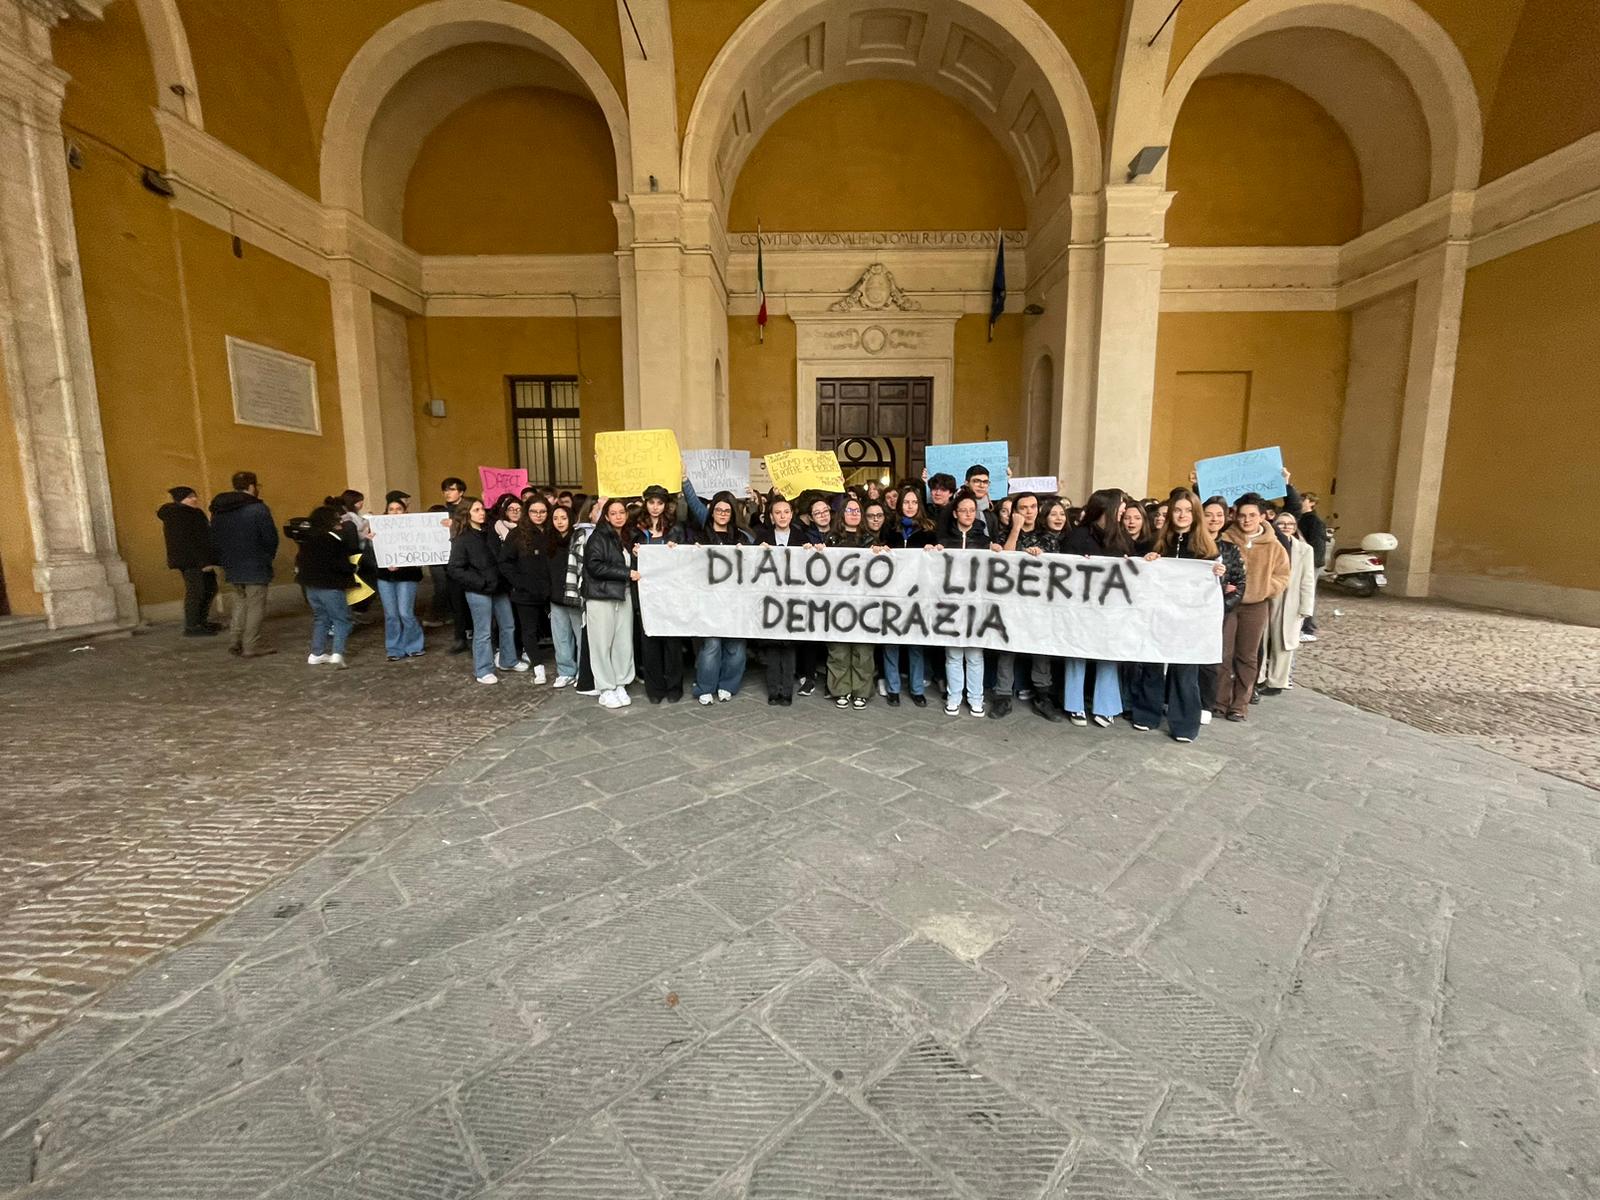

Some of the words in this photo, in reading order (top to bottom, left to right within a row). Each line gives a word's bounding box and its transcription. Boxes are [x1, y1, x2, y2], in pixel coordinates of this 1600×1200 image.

[740, 233, 801, 246] CONVITTO
[804, 232, 866, 246] NAZIONALE
[970, 231, 1024, 244] GINNSIO
[385, 550, 449, 565] DISORDINE
[762, 595, 1010, 643] DEMOCRAZIA
